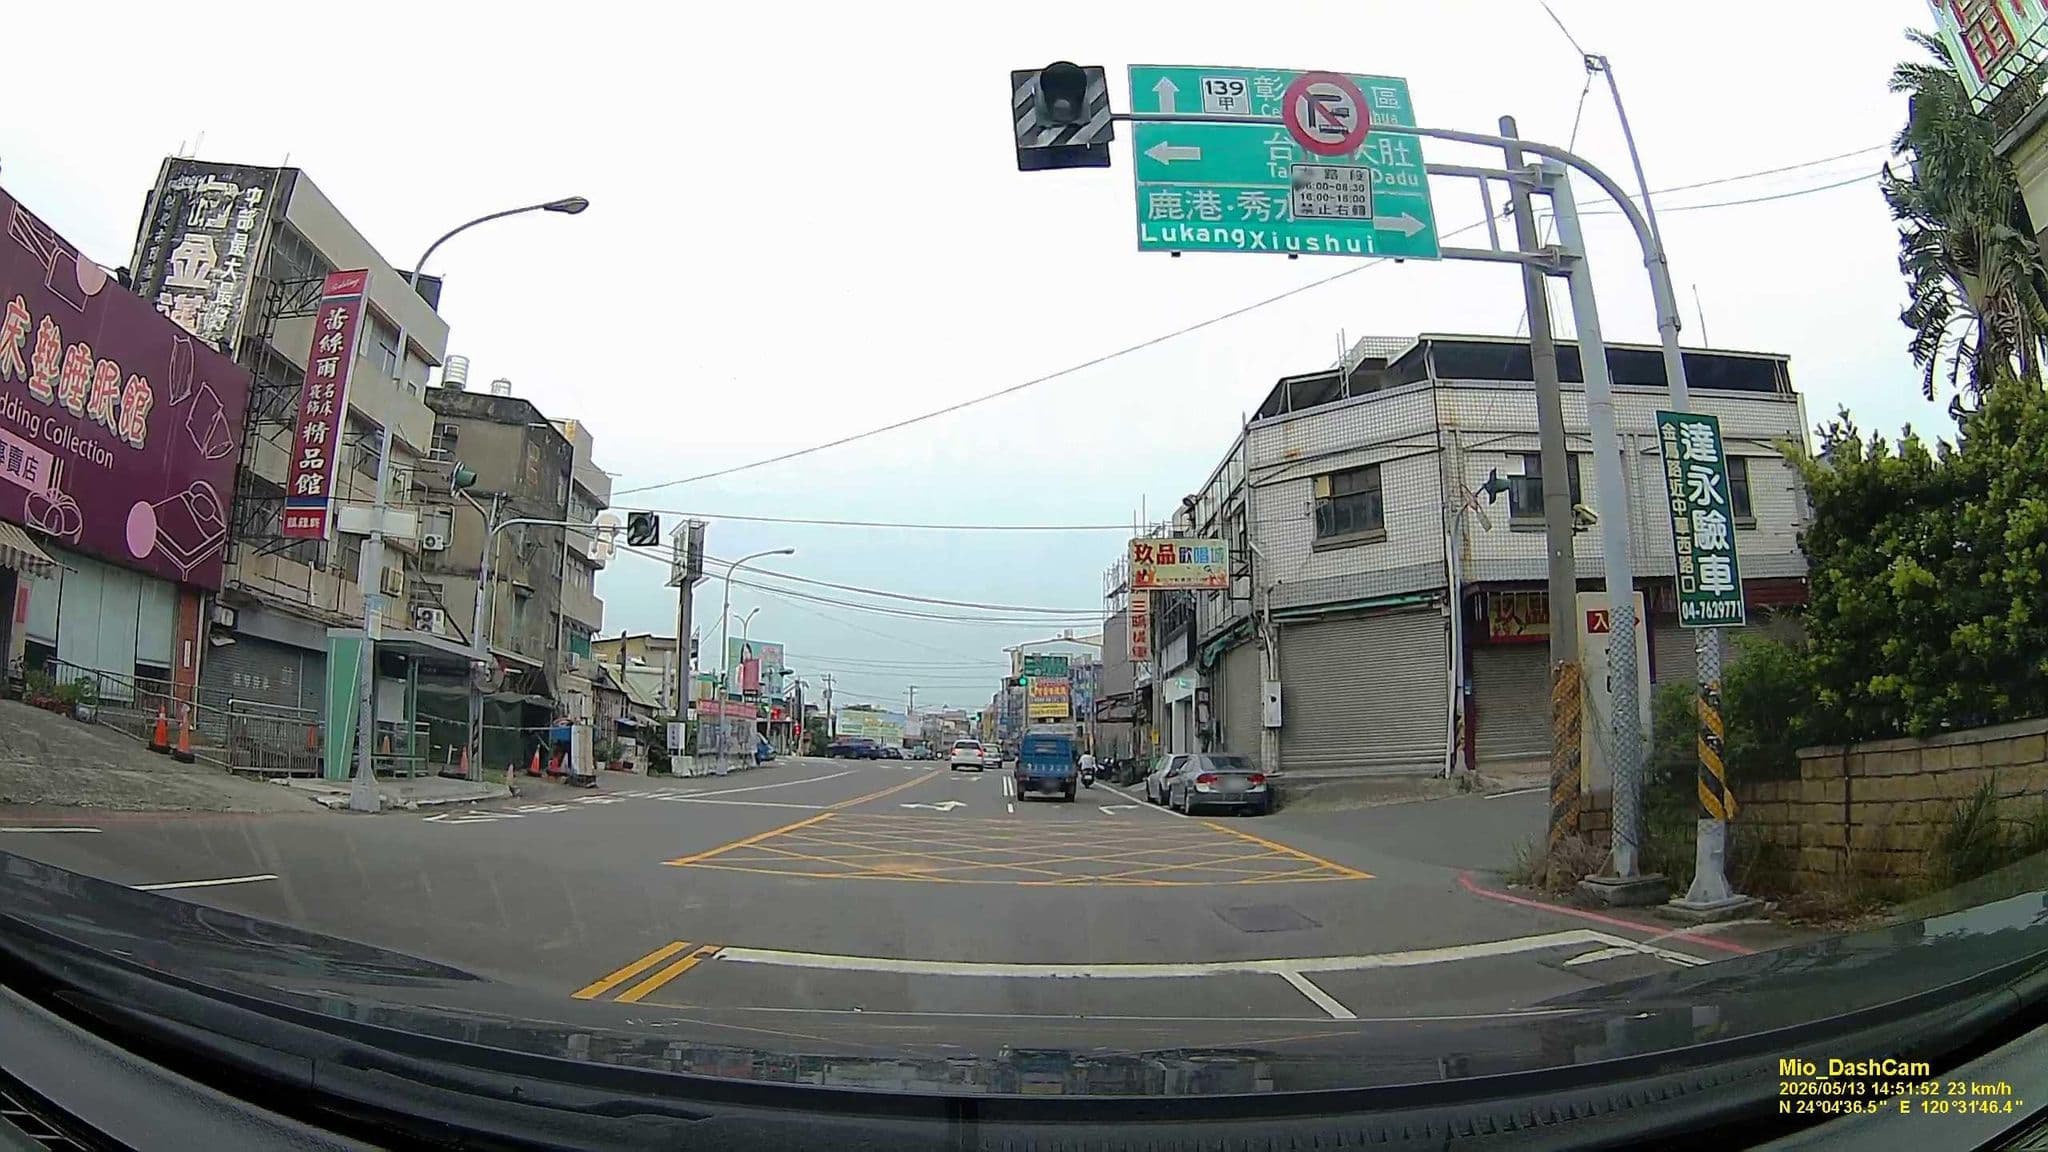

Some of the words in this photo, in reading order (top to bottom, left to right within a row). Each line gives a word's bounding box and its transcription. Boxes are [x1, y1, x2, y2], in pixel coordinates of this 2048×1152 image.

[1205, 80, 1244, 96] 139
[1254, 76, 1400, 109] 彰區
[1218, 97, 1234, 111] 甲
[1302, 167, 1364, 181] 路段
[1303, 182, 1365, 193] 6:00-08:30
[1142, 224, 1244, 248] Lukang
[1251, 231, 1374, 253] Xiushui
[0, 295, 152, 448] 床墊睡眠館
[44, 418, 114, 469] Collection
[295, 420, 330, 495] 精品館
[1680, 422, 1734, 596] 達永驗車
[1682, 601, 1742, 620] 04-7629771
